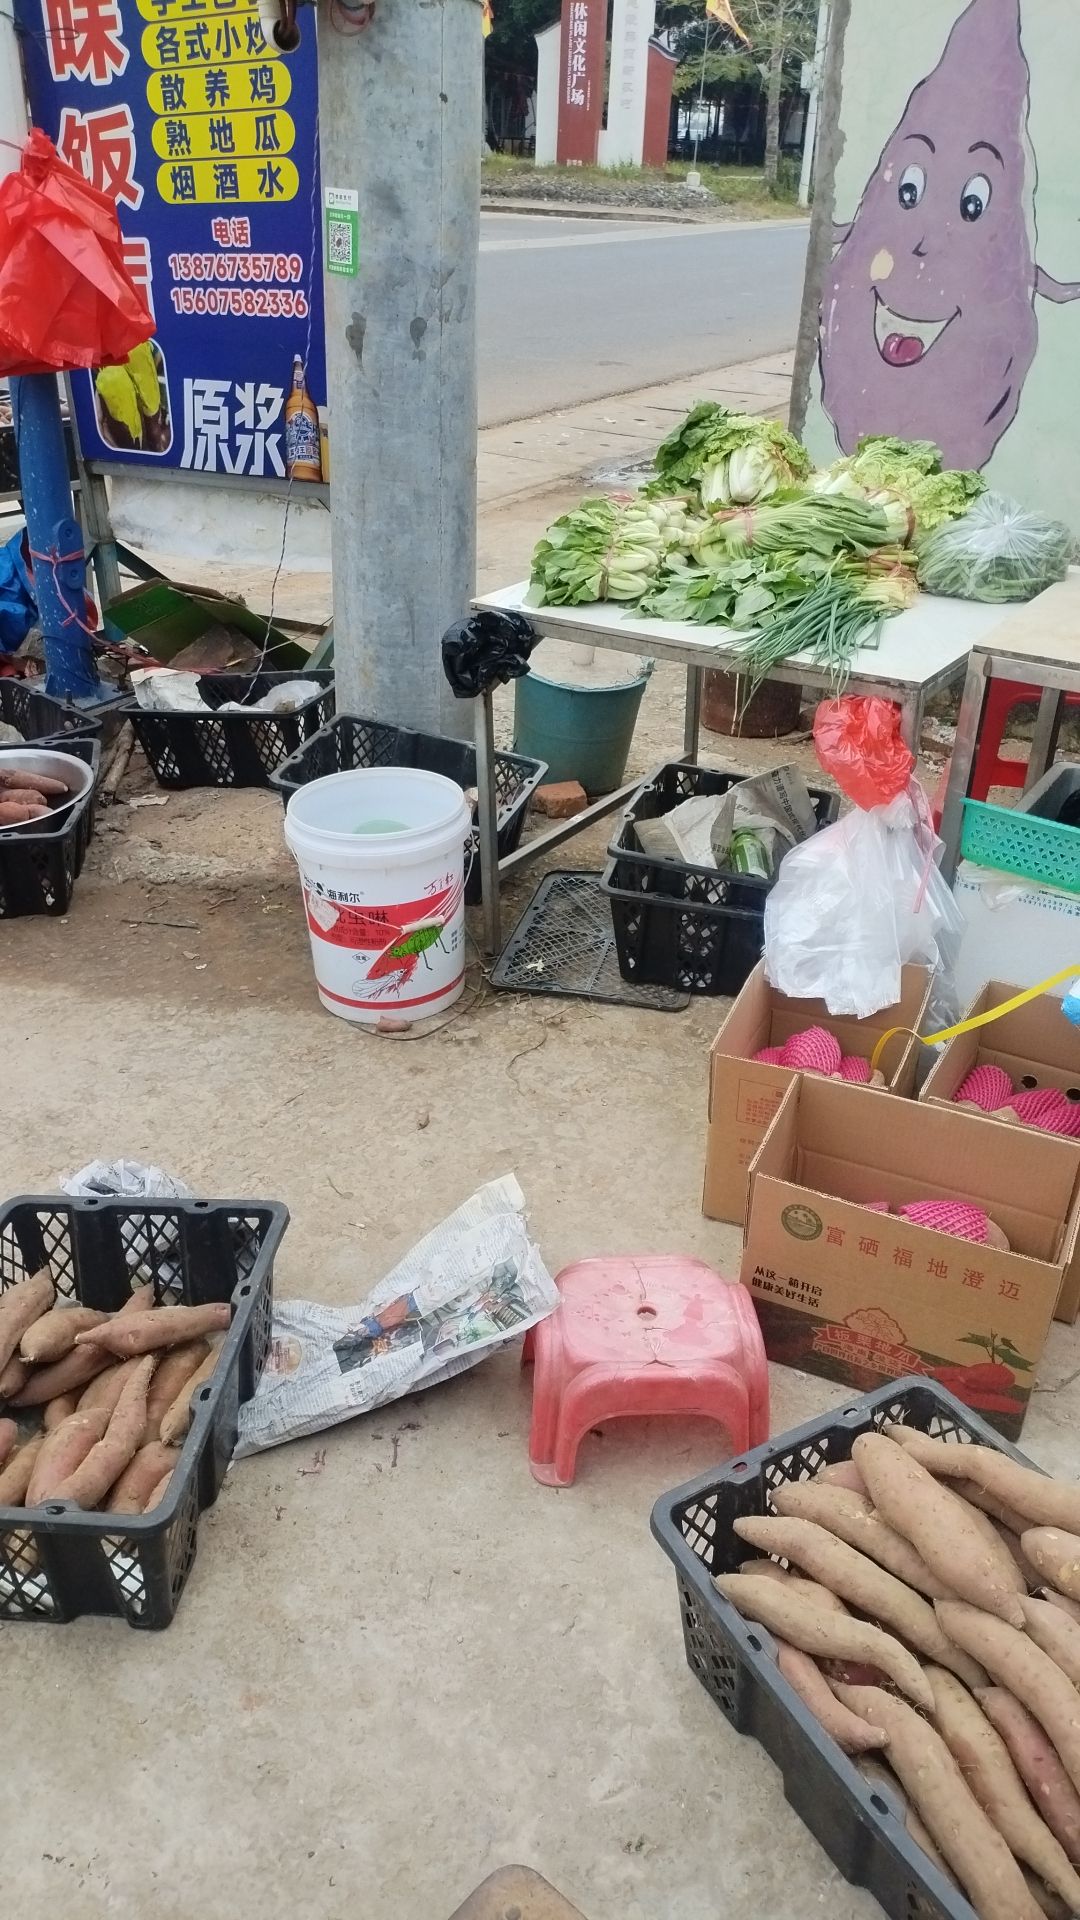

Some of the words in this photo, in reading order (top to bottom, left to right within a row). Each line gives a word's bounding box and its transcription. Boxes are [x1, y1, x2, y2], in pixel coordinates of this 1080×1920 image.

[156, 17, 268, 65] 各式小炒
[571, 2, 588, 106] 休闲文化广场
[160, 65, 276, 111] 散养鸡
[166, 113, 281, 156] 熟地瓜
[42, 0, 156, 332] 味饭
[170, 161, 285, 201] 烟酒水
[211, 217, 251, 247] 电话
[169, 253, 303, 282] 13876735789
[171, 288, 308, 318] 15607582336
[180, 378, 287, 477] 原浆
[327, 888, 361, 904] 海利尔
[754, 1265, 823, 1297] 从这一箱开启
[825, 1225, 1022, 1302] 富硒福地澄迈
[752, 1276, 820, 1308] 健康美好生活
[833, 1330, 910, 1363] 板栗地瓜
